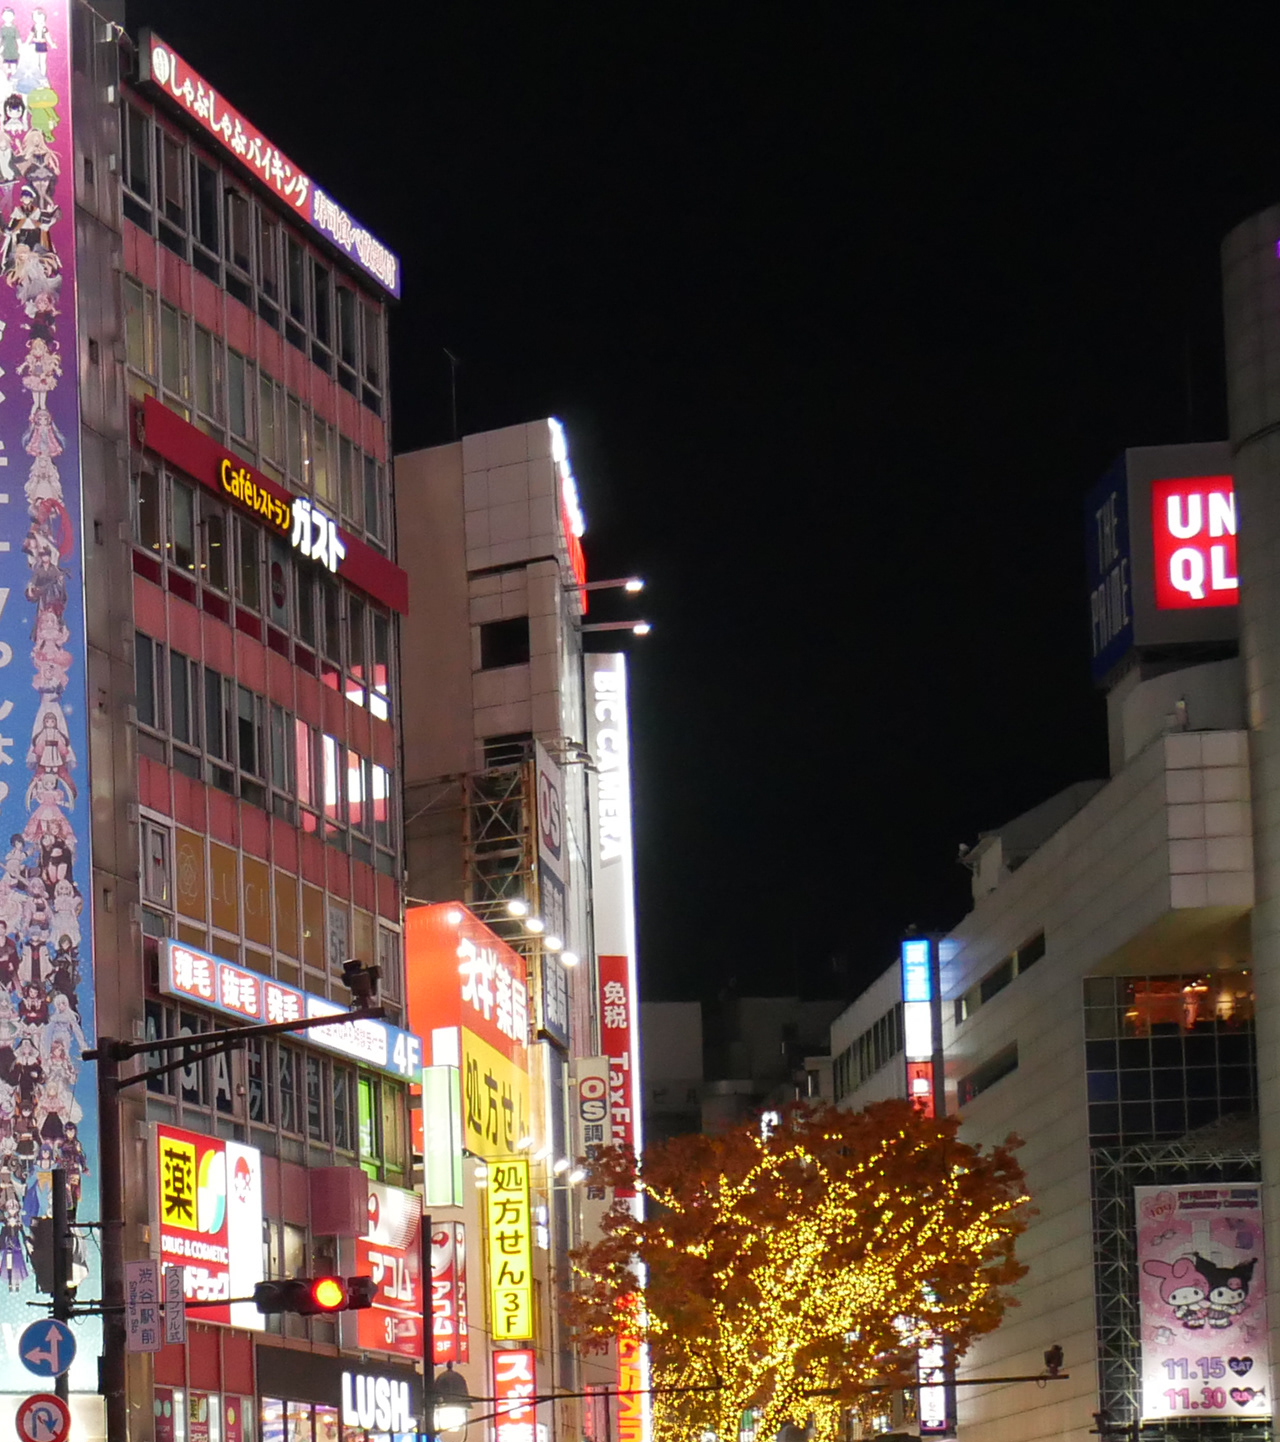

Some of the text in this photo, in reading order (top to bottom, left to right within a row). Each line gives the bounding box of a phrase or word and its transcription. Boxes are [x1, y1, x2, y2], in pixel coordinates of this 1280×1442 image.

[169, 53, 310, 207] しゃぶしゃぶバイキング
[219, 459, 346, 573] Caféレストラン ガスト
[593, 671, 624, 862] BIC CAMERA
[456, 937, 529, 1050] スギ薬局
[603, 980, 628, 1029] 免税
[392, 1033, 421, 1078] 4F
[164, 1148, 193, 1220] 薬
[492, 1166, 526, 1286] 処方せん
[129, 1280, 138, 1316] Shibuya
[368, 1251, 413, 1302] アコム
[139, 1268, 157, 1346] 渋谷駅前
[384, 1316, 398, 1344] 3F
[431, 1280, 453, 1335] アコム
[458, 1282, 468, 1335] アコム
[501, 1292, 521, 1335] 3F
[436, 1340, 452, 1351] 3F
[1161, 1356, 1252, 1380] 11.15 SAT
[1163, 1386, 1227, 1411] 11.30
